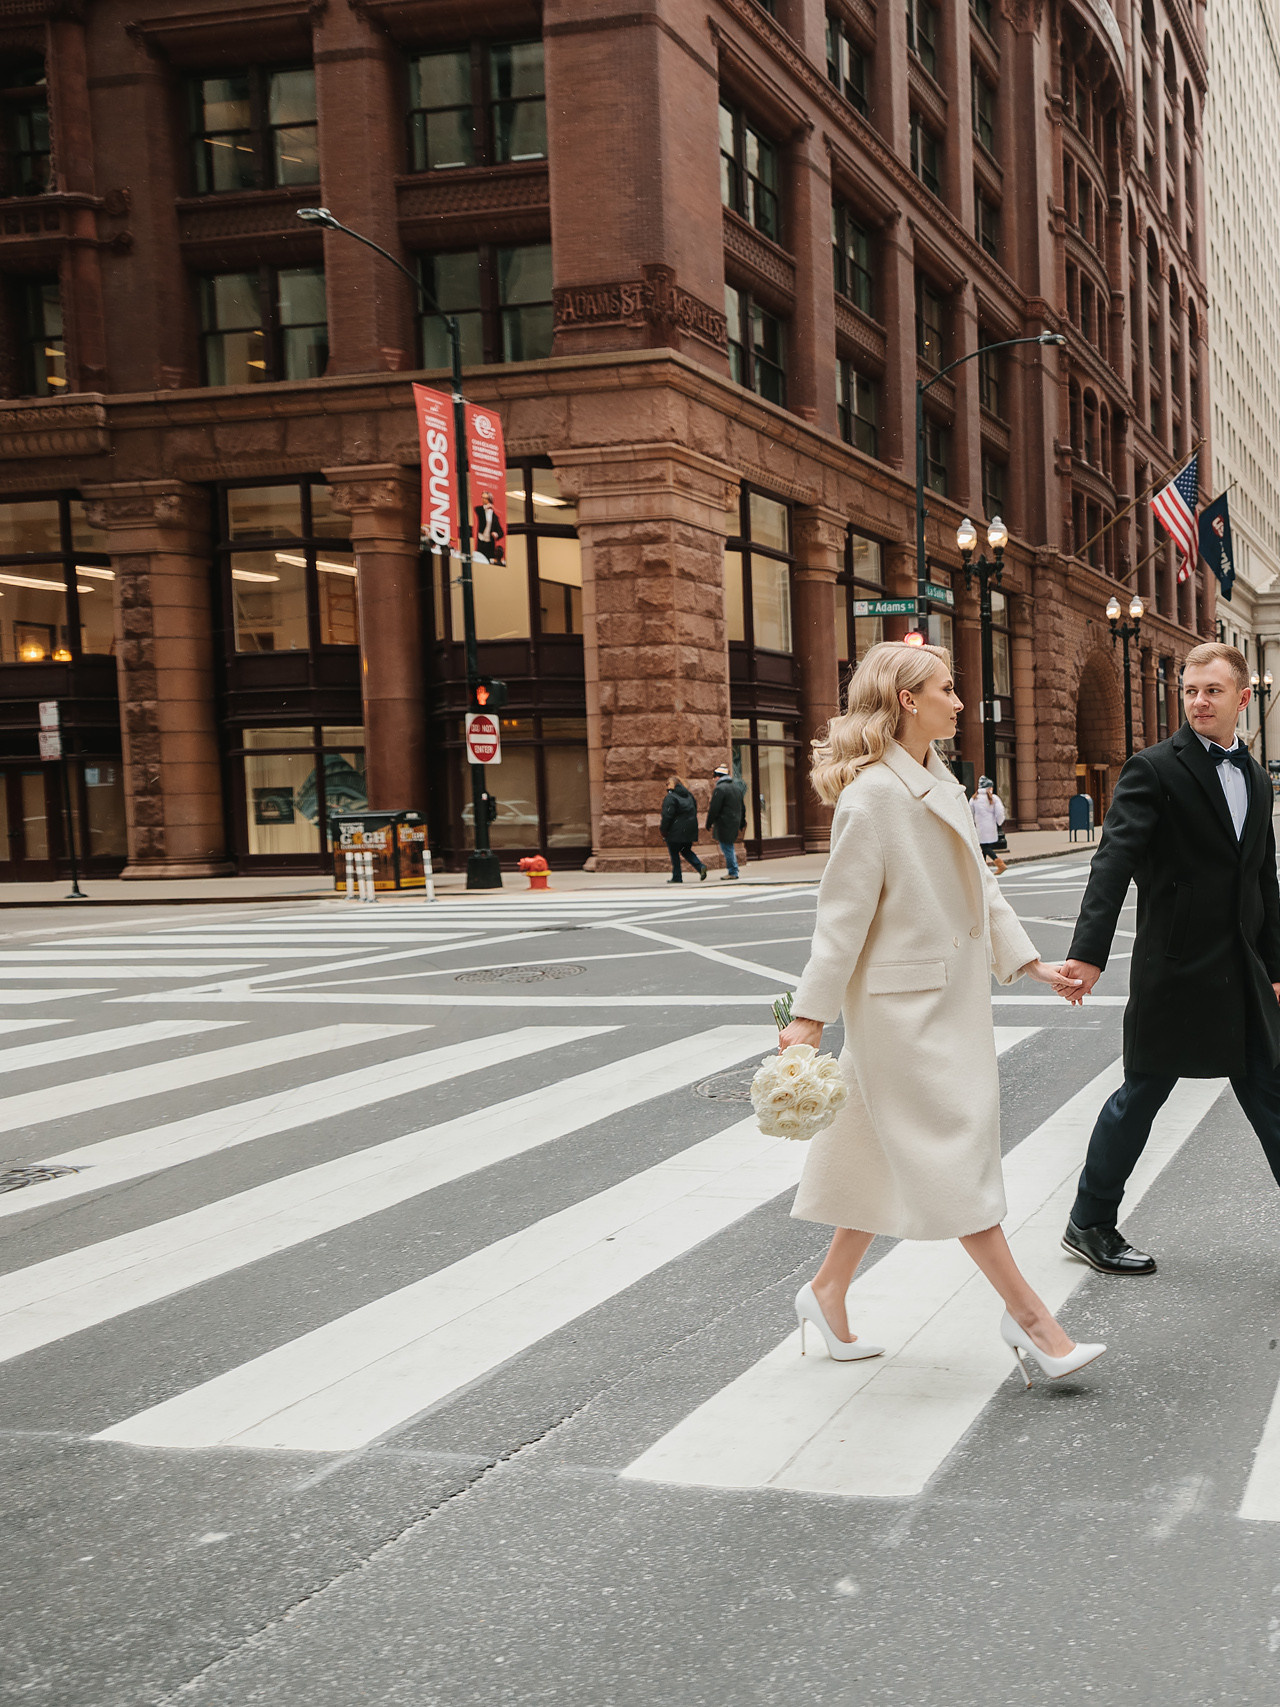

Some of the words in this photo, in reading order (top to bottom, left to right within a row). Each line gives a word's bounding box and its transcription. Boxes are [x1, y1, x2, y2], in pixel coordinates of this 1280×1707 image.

[561, 291, 619, 321] ADAMS
[426, 429, 451, 546] SOUND
[875, 602, 906, 613] Adams
[471, 724, 480, 732] DO
[482, 724, 494, 732] NOT
[474, 745, 494, 754] ENTER
